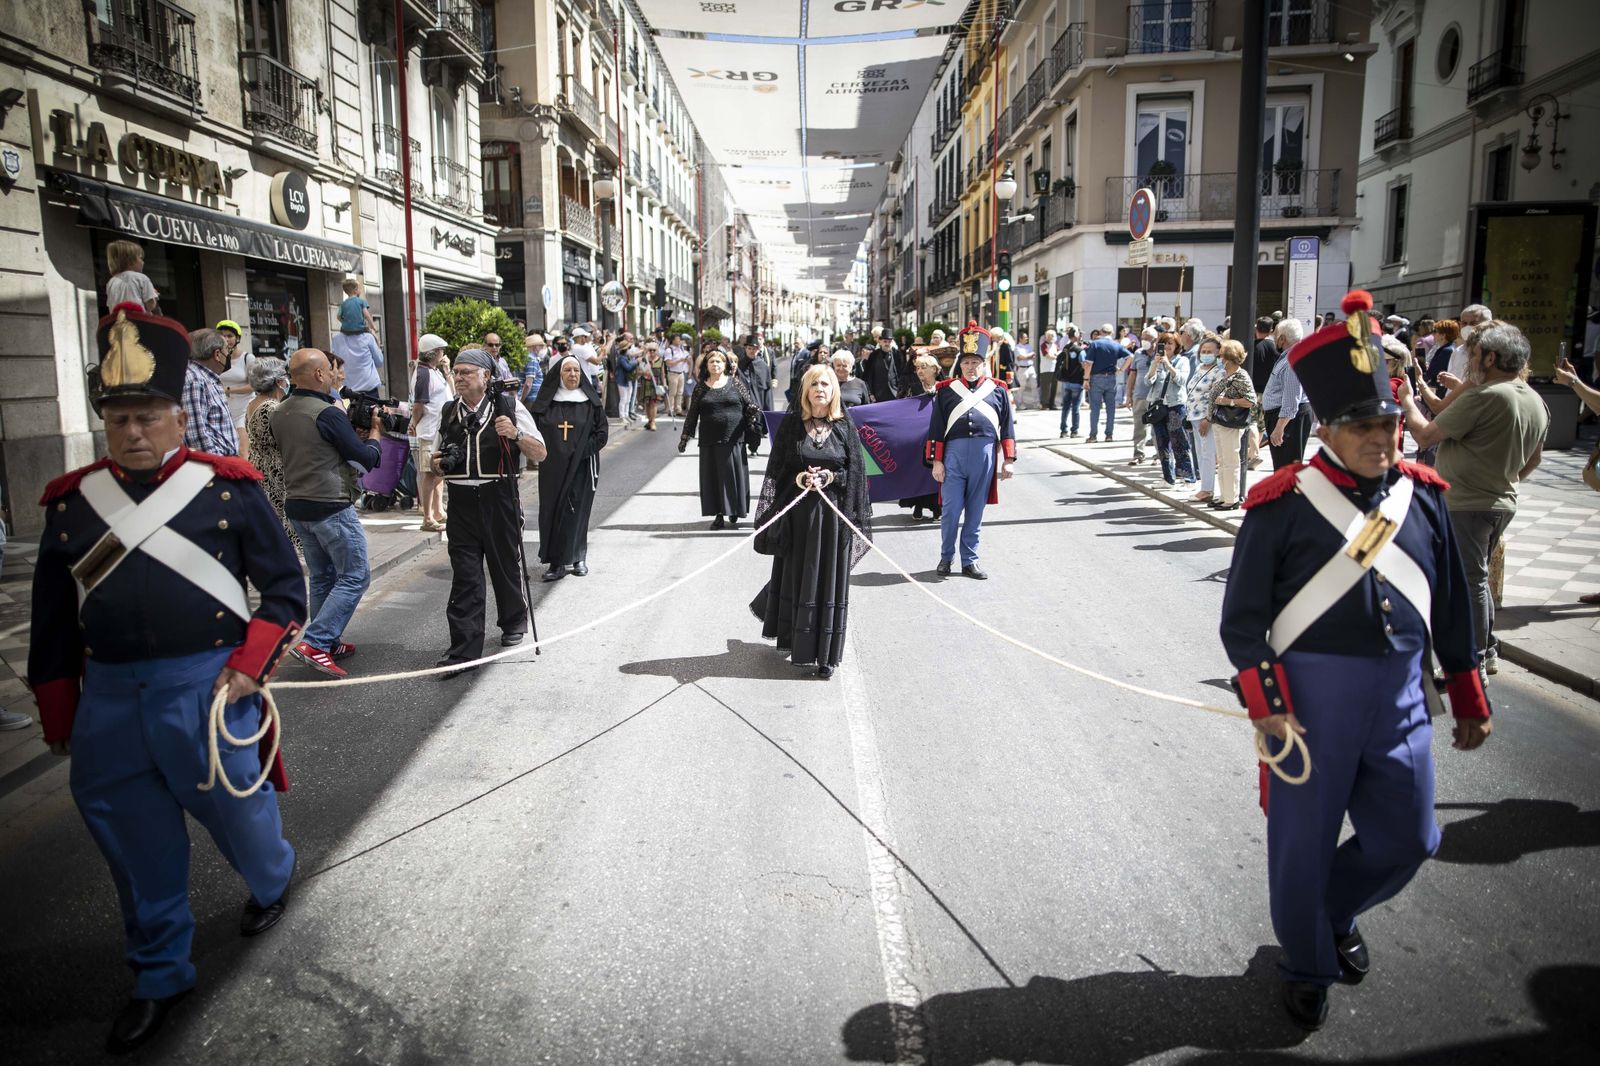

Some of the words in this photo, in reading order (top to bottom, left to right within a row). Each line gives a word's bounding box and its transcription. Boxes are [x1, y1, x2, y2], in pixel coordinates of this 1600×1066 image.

[825, 84, 911, 95] ALHAMBRA
[830, 78, 908, 89] CERVEZAS
[49, 109, 117, 165] LA
[118, 132, 226, 195] CUEVA
[113, 205, 140, 233] LA
[143, 212, 204, 244] CUEVA
[206, 229, 218, 246] de
[218, 233, 240, 250] 1900
[274, 240, 291, 260] LA
[292, 243, 330, 268] CUEVA
